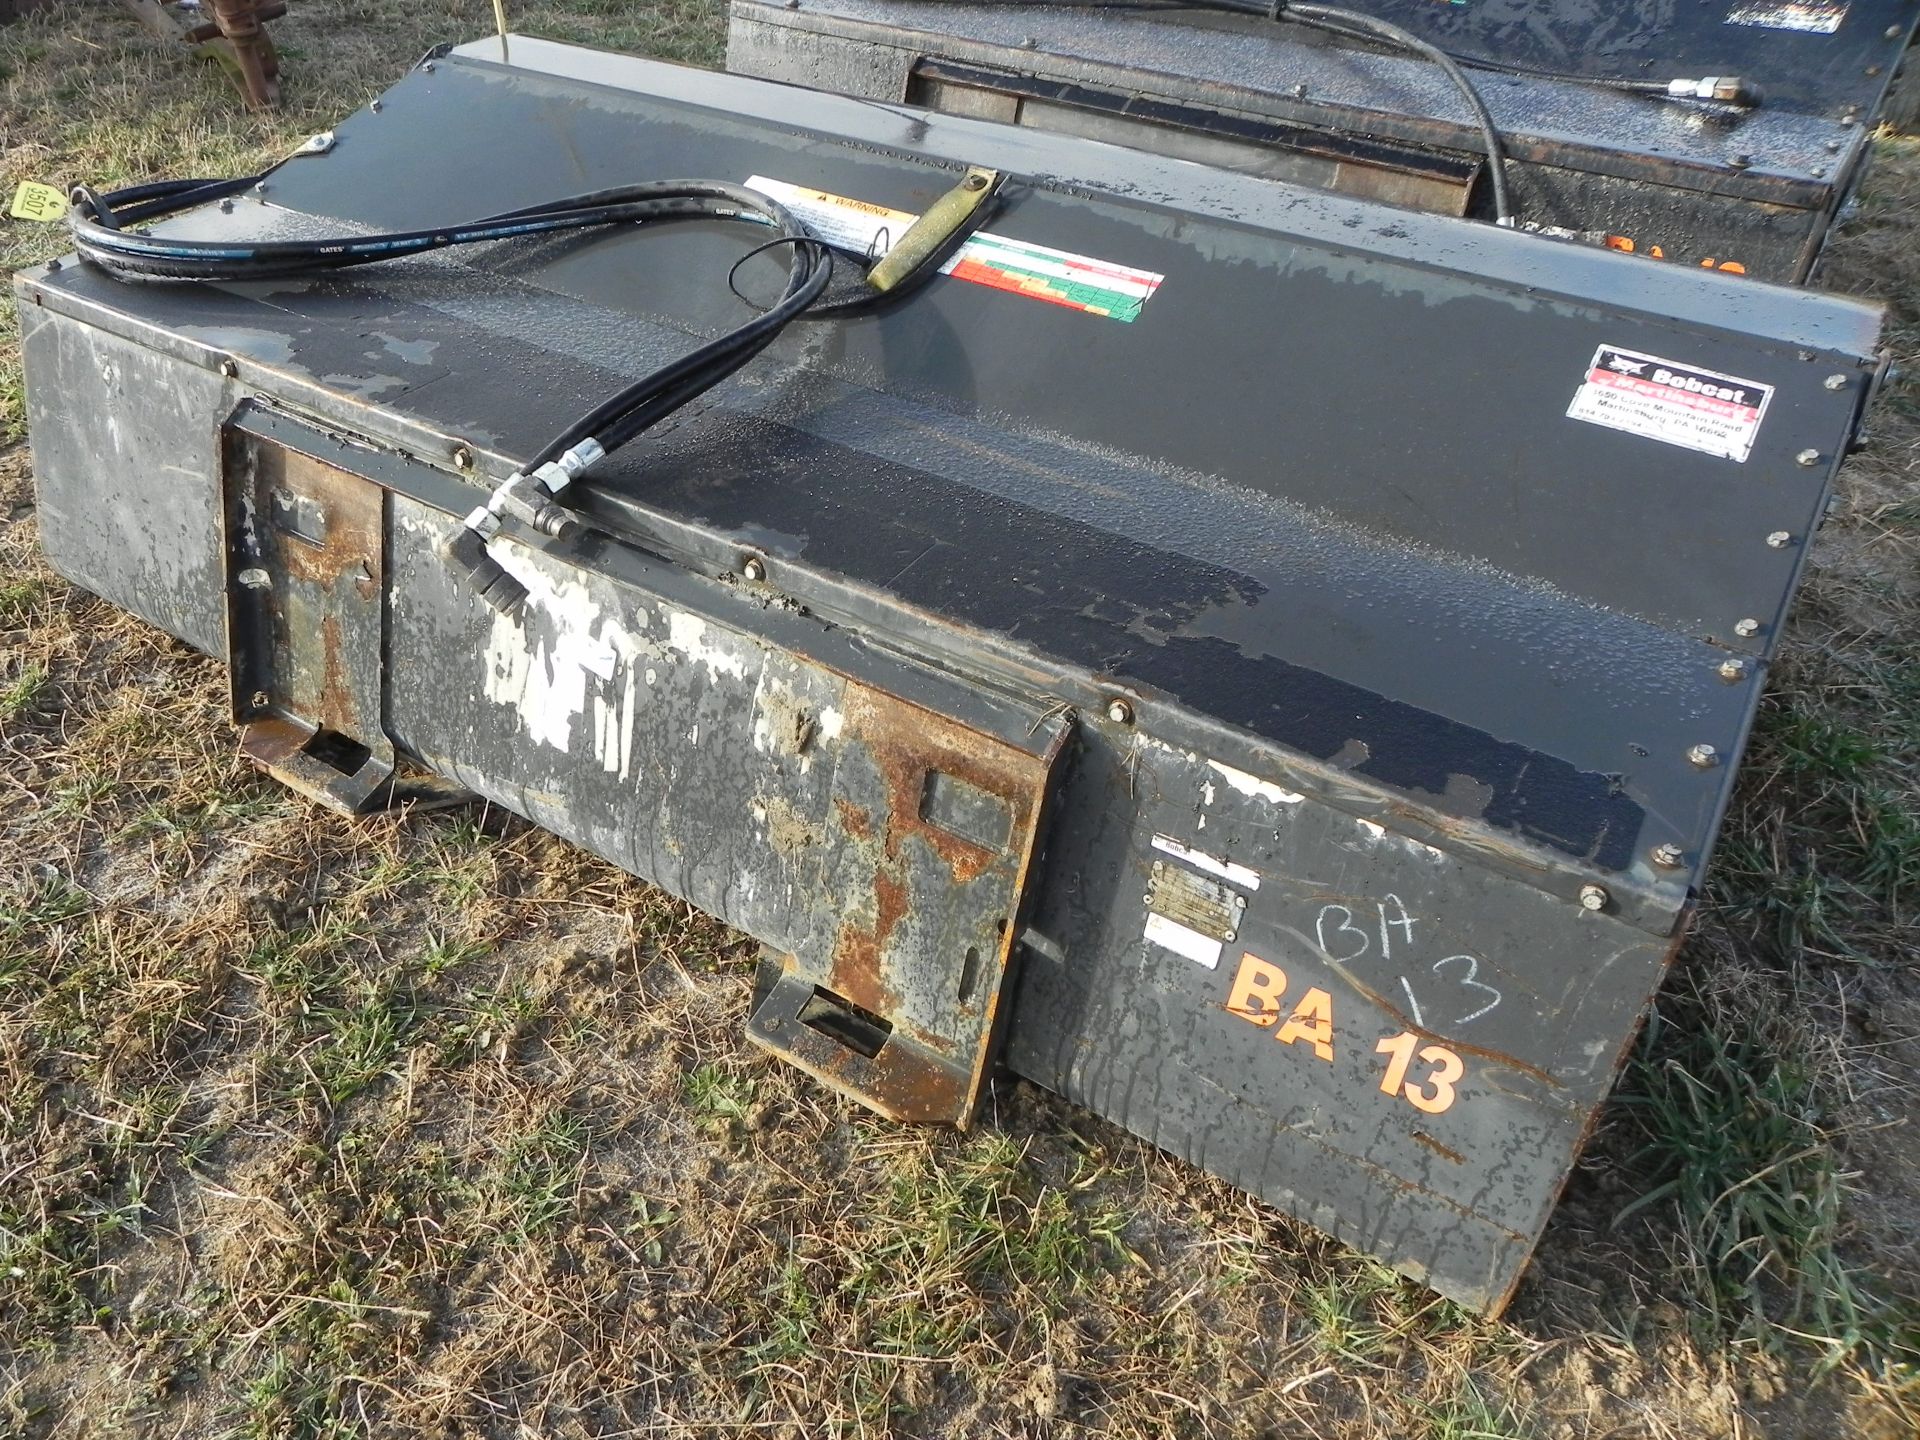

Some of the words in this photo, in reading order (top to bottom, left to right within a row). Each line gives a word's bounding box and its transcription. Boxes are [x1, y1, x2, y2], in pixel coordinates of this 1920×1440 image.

[25, 187, 49, 216] 3507
[835, 198, 890, 217] WARNING
[319, 246, 345, 255] GATES
[1652, 368, 1746, 404] Bobcat
[1653, 402, 1709, 425] Mountain
[1316, 893, 1419, 963] BA
[1400, 954, 1501, 1027] 13
[1226, 951, 1334, 1062] BA
[1375, 1031, 1465, 1114] 13
